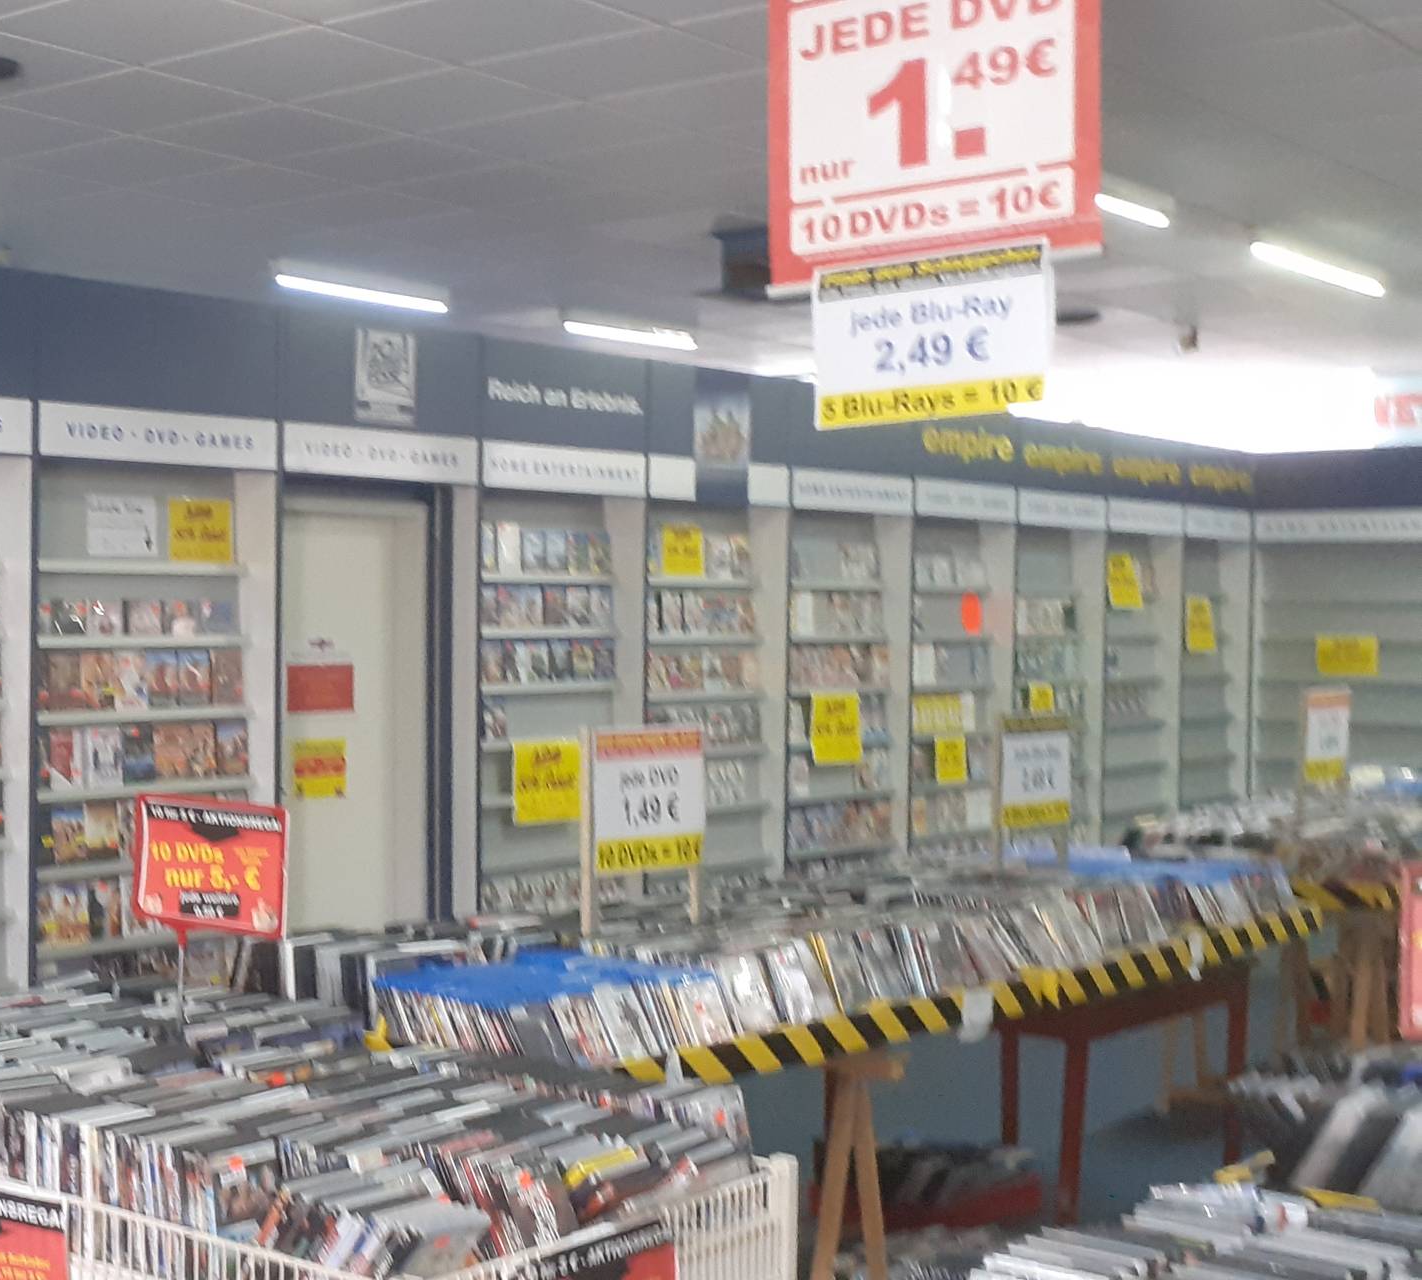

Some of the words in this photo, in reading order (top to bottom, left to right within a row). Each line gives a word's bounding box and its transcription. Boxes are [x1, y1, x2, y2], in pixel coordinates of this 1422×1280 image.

[800, 3, 929, 61] JEDE
[799, 157, 855, 186] nur
[850, 307, 903, 338] jede
[910, 295, 1010, 325] Blu-Ray
[874, 332, 953, 376] 2,49
[965, 326, 991, 362] €
[487, 376, 543, 405] Reich
[543, 388, 569, 408] an
[842, 389, 956, 420] Blu-Rays
[65, 421, 124, 441] VIDEO
[144, 429, 179, 446] DVD
[195, 431, 255, 451] GAMES
[149, 839, 173, 863] 10
[175, 841, 225, 865] DVDs
[164, 867, 205, 889] nur
[243, 865, 261, 891] €
